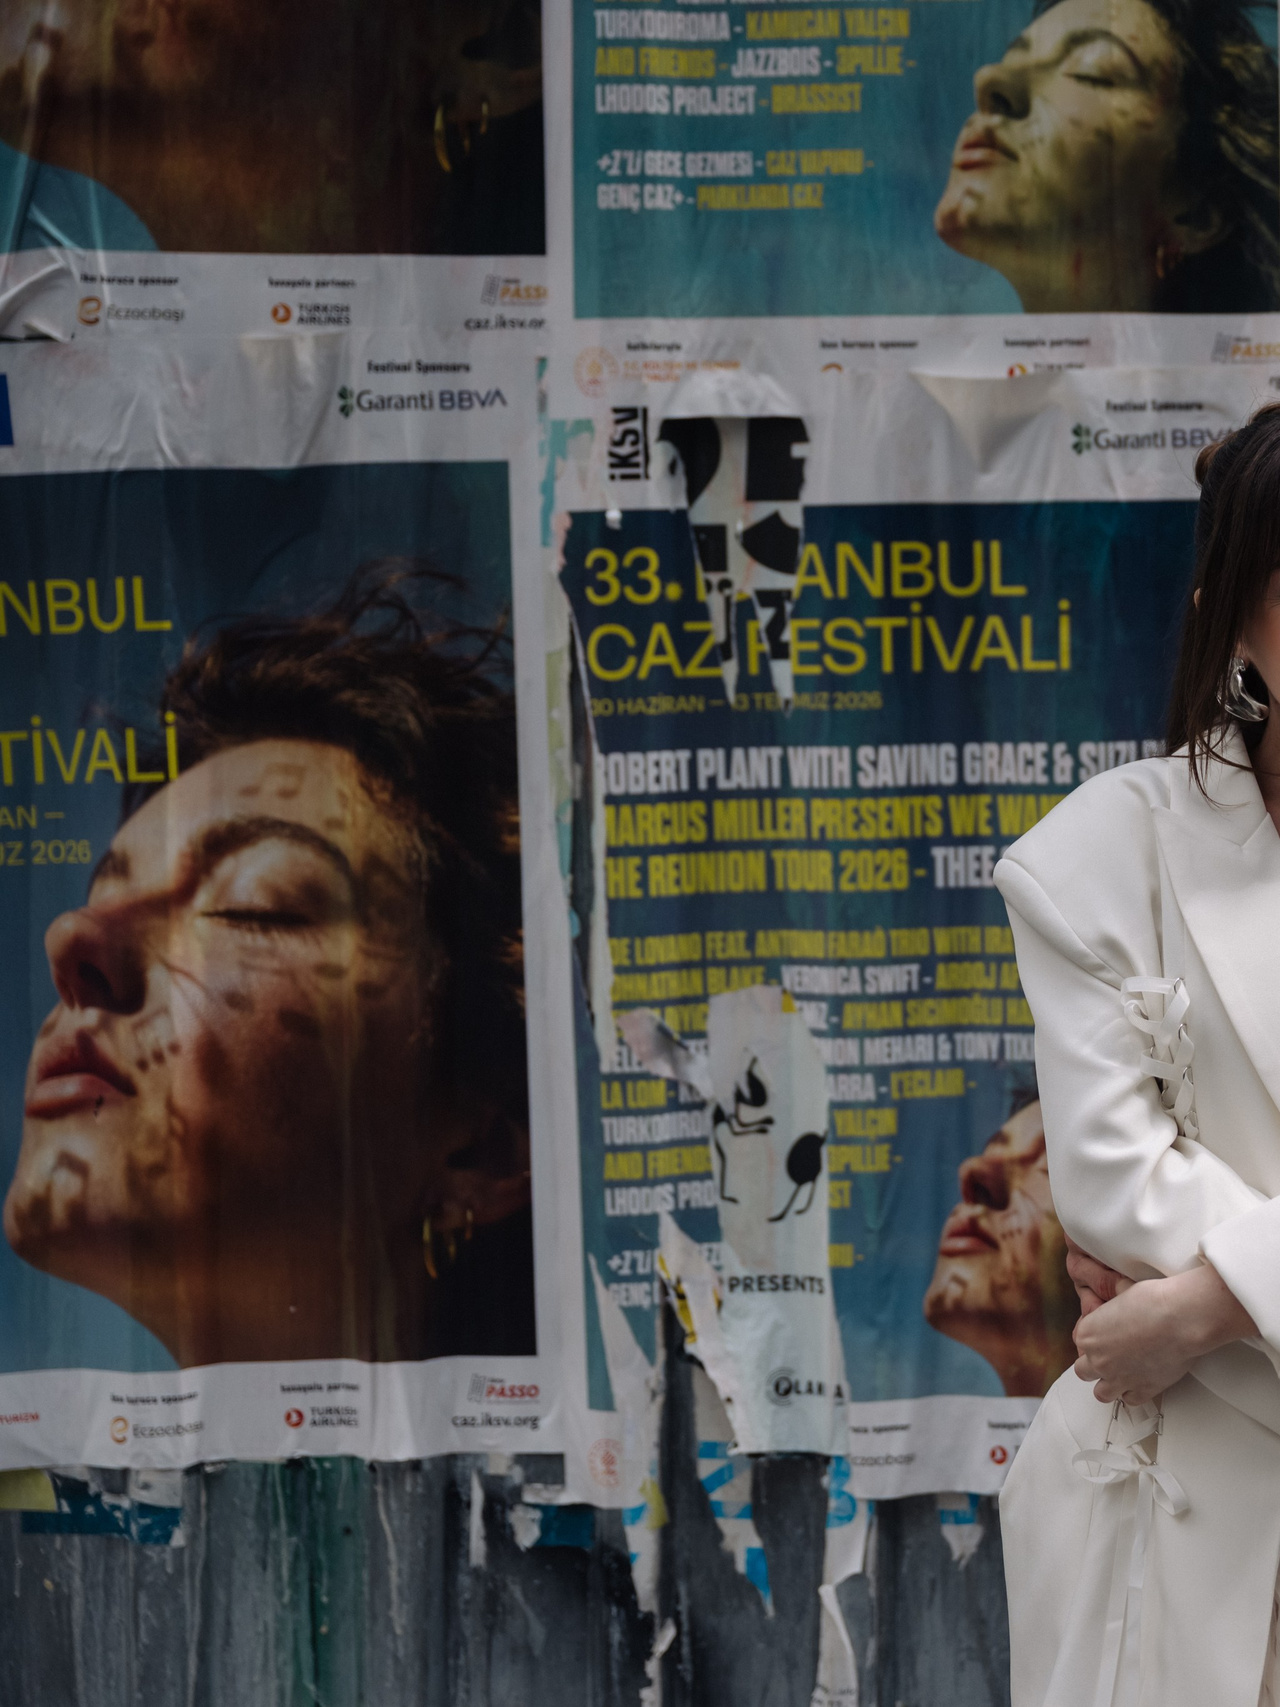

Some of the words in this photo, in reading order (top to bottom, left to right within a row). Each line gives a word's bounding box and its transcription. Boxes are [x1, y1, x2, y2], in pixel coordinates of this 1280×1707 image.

[673, 85, 757, 115] PROJECT
[357, 389, 433, 411] Garanti
[439, 388, 507, 410] BBVA
[1095, 428, 1166, 450] Garanti
[587, 621, 723, 681] CAZ
[834, 691, 882, 710] 2026
[696, 746, 783, 791] PLANT
[787, 745, 850, 788] WITH
[857, 743, 957, 788] SAVING
[962, 742, 1048, 785] GRACE
[1052, 742, 1074, 784] &
[713, 798, 807, 842] MILLER
[811, 795, 943, 839] PRESENTS
[948, 794, 992, 837] WE
[32, 839, 92, 864] 2026
[648, 852, 767, 897] REUNION
[771, 850, 834, 892] TOUR
[839, 848, 909, 892] 2026
[865, 963, 920, 994] SWIFT
[729, 1275, 825, 1295] PRESENTS
[486, 1384, 539, 1399] PASSO
